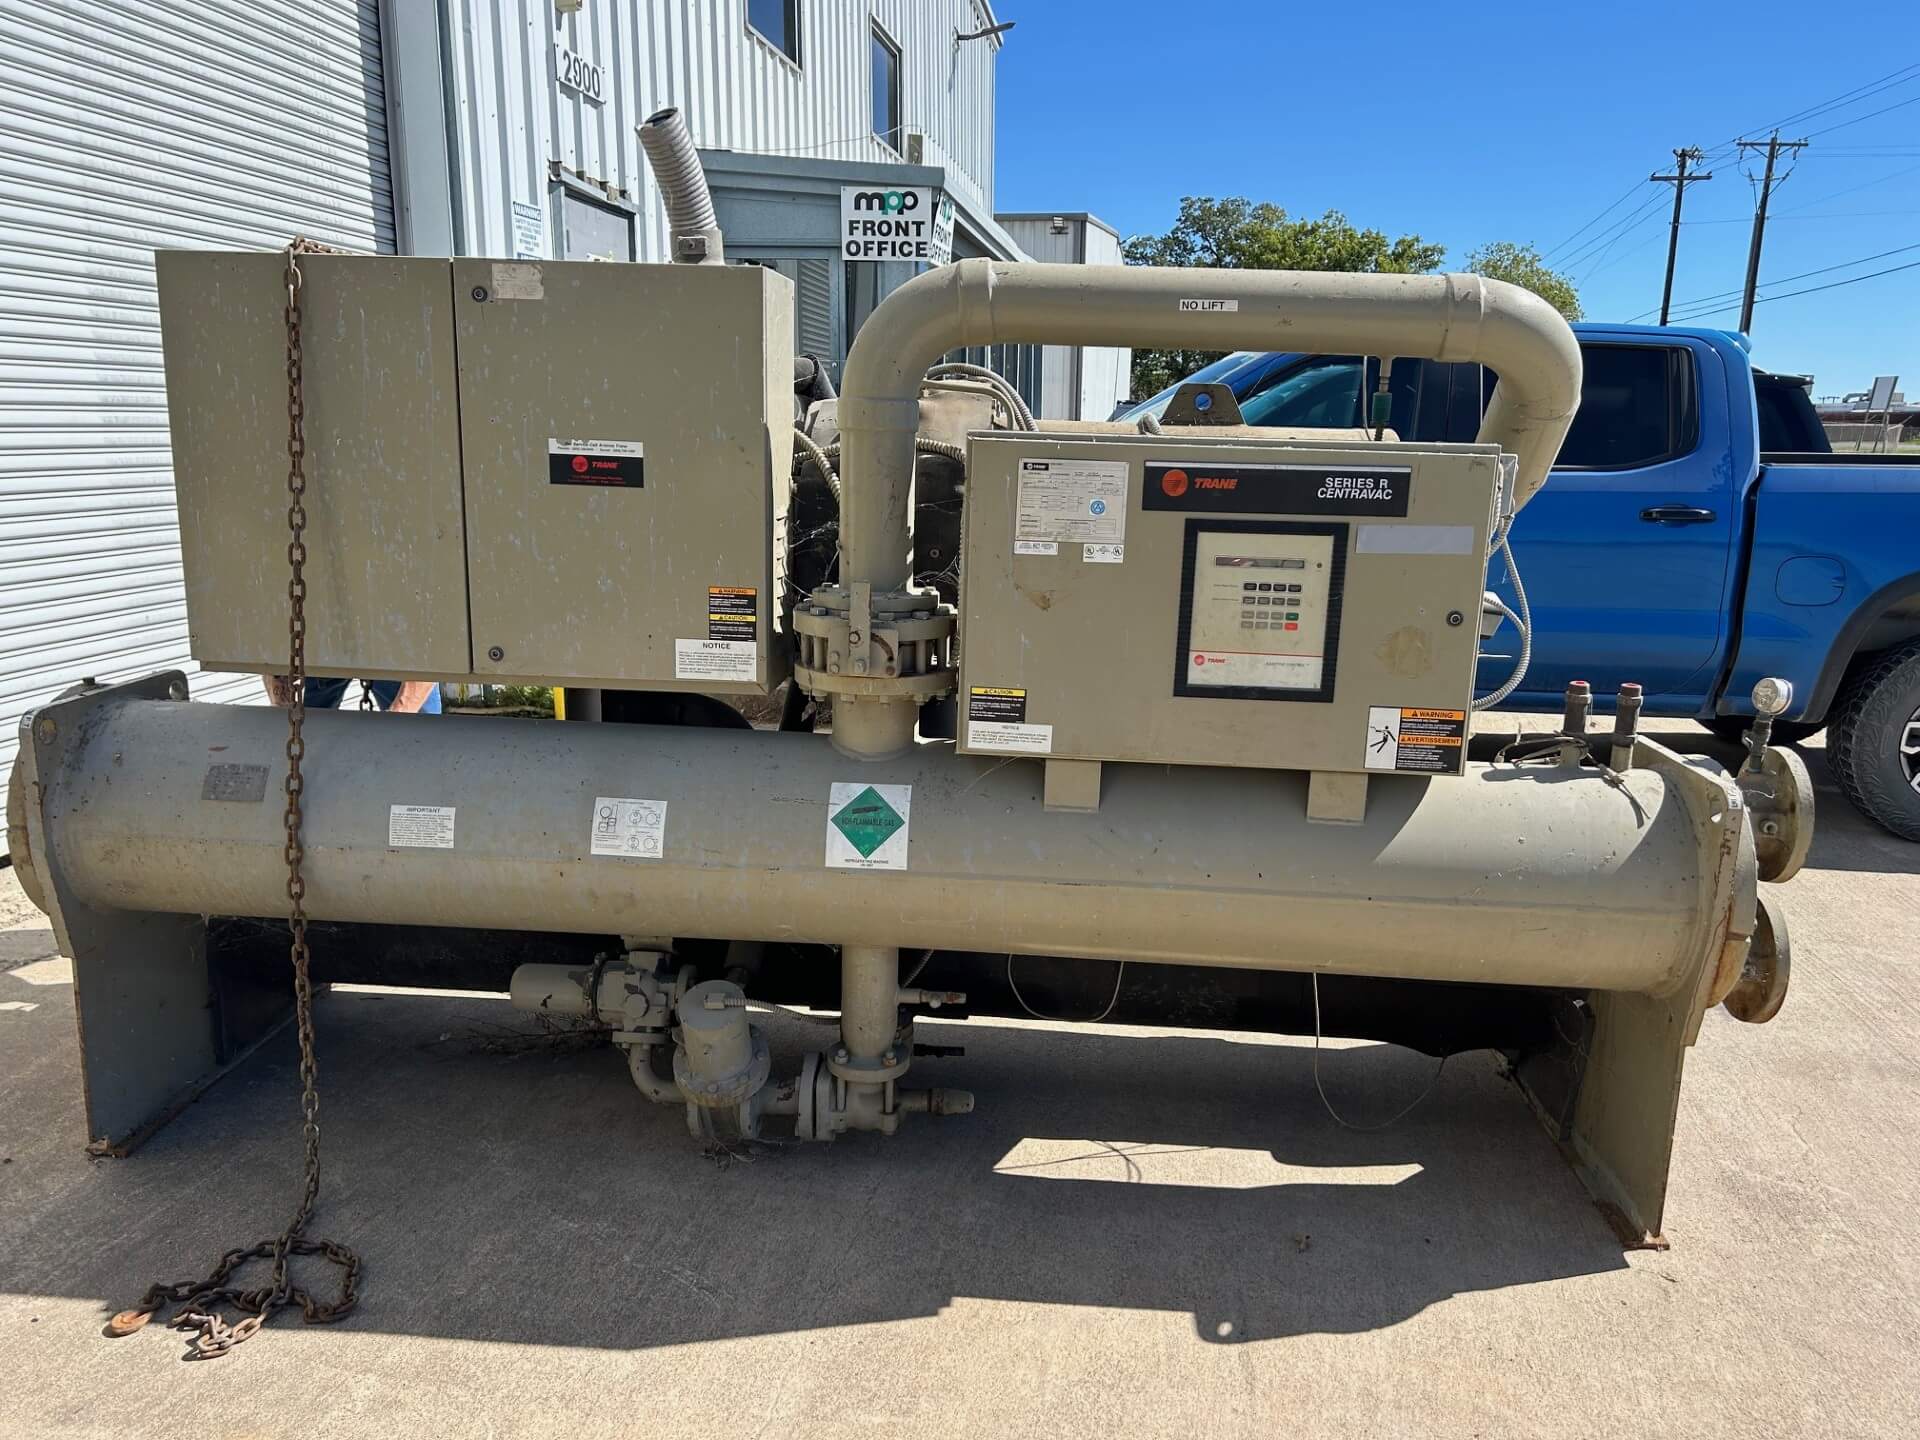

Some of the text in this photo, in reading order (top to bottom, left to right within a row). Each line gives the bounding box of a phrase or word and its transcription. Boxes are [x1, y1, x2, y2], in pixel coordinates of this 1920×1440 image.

[563, 49, 600, 98] 2900
[854, 191, 918, 215] mpp
[514, 204, 541, 221] WARNING
[848, 220, 925, 237] FRONT
[845, 240, 928, 258] OFFICE
[1182, 301, 1224, 310] NO LIFT
[1194, 478, 1238, 489] TRANE
[1325, 477, 1388, 488] SERIES R
[1317, 488, 1393, 500] CENTRAVAC
[1419, 711, 1454, 719] WARNING
[1407, 737, 1460, 745] AVERTISSEMENT
